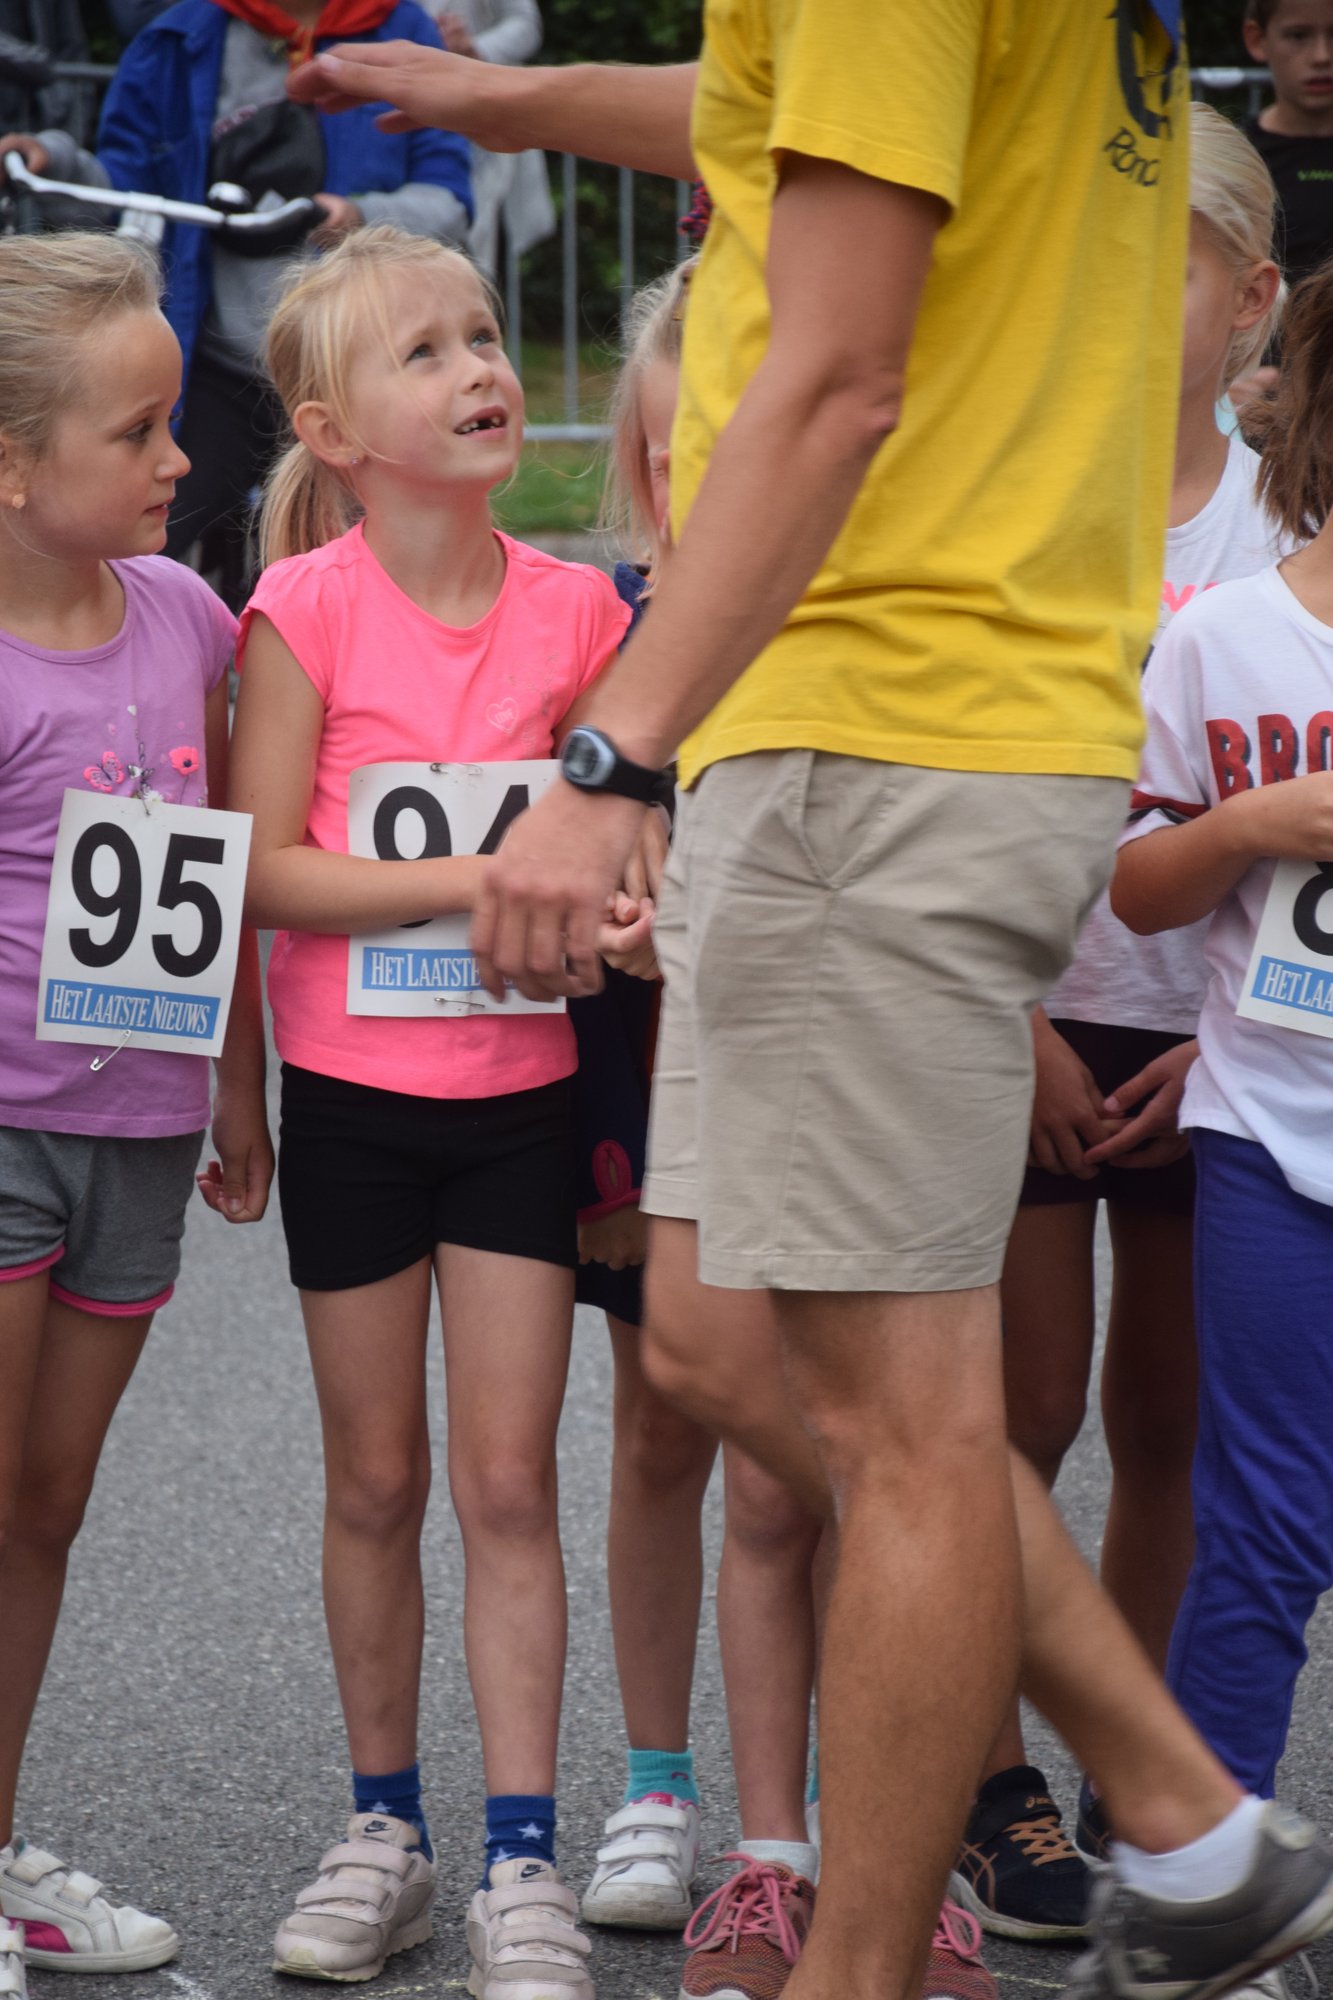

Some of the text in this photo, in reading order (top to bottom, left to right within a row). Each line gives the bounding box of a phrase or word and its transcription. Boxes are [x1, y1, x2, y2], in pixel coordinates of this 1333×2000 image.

[69, 822, 225, 977] 95
[371, 951, 405, 986] HET
[1261, 962, 1302, 1002] HET
[50, 984, 211, 1034] HET LAATSTE NIEUWS
